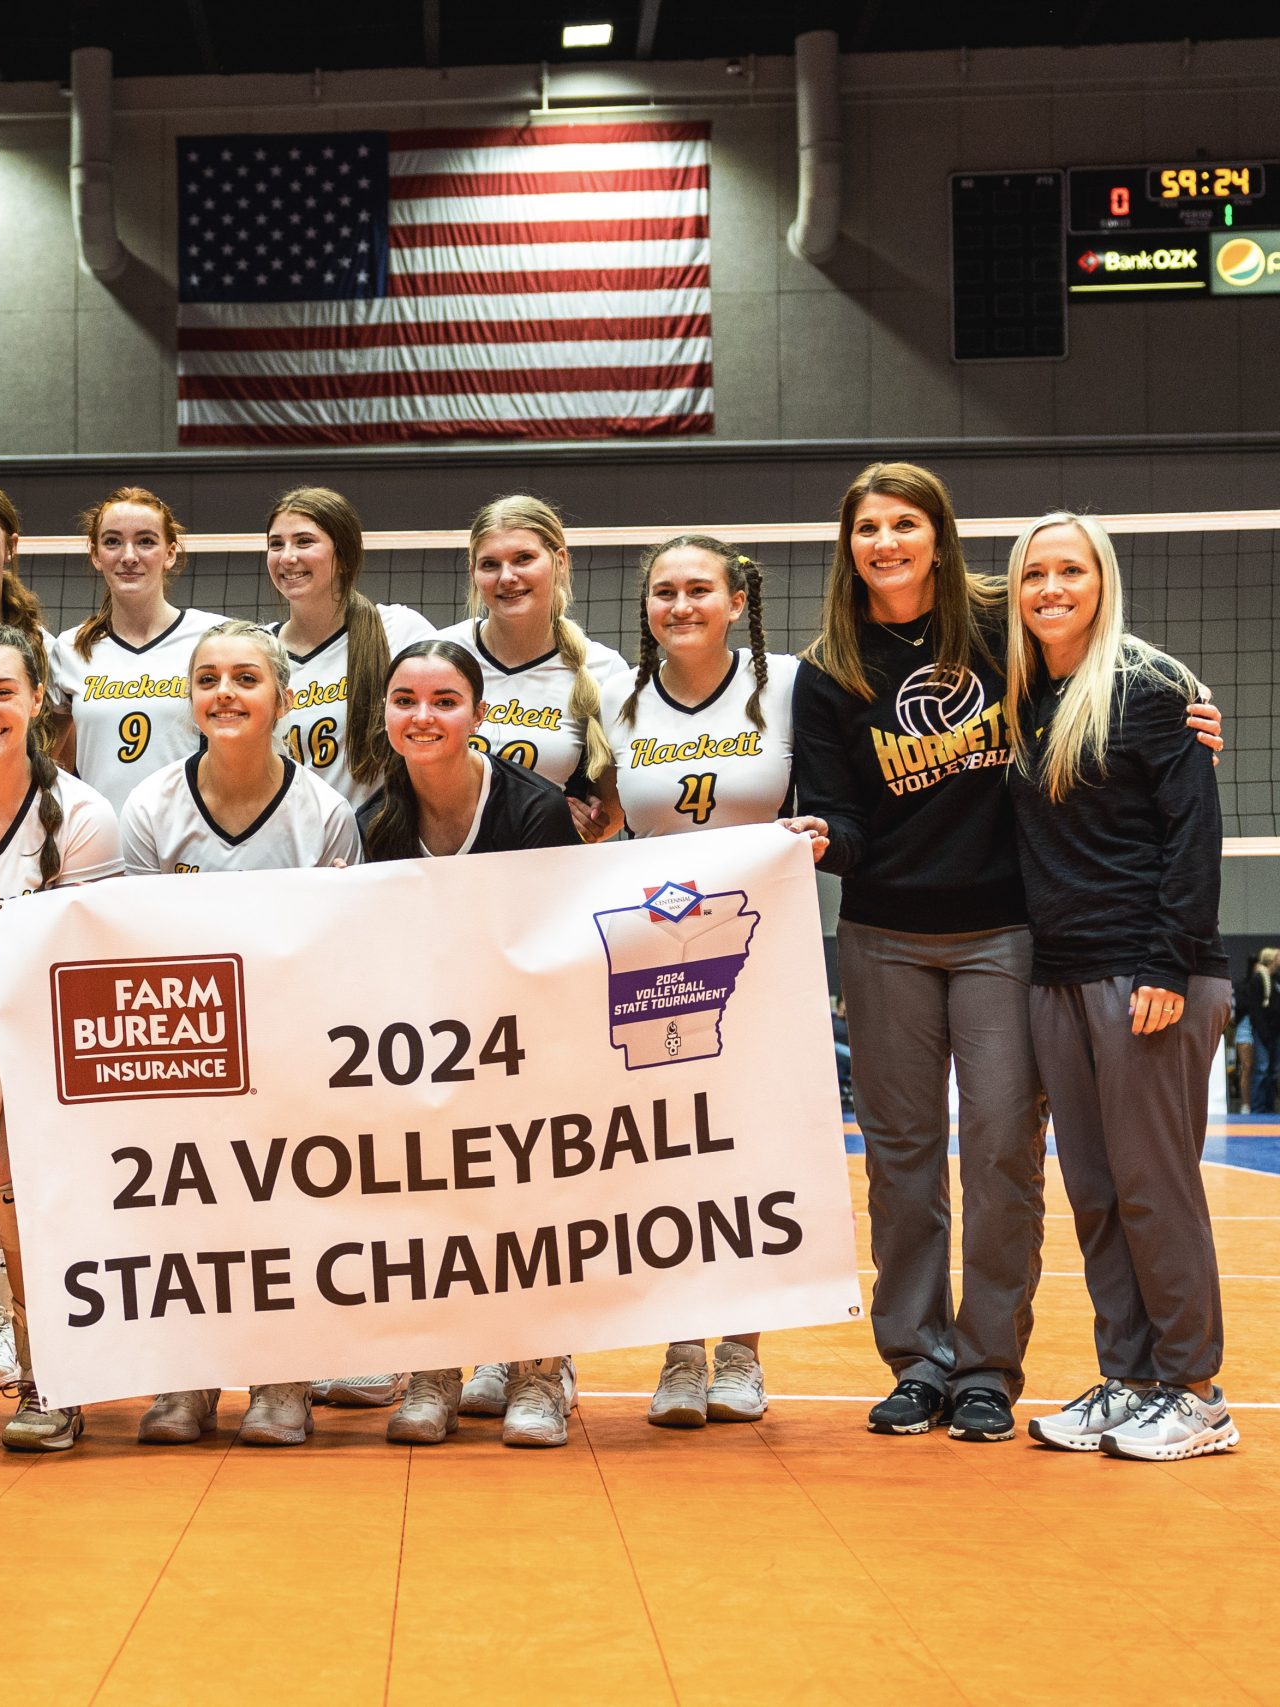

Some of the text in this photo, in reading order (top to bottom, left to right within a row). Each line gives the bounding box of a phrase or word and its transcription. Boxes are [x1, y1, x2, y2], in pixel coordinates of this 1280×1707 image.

[1160, 167, 1250, 199] 59:24
[1110, 187, 1130, 216] 0
[1224, 204, 1233, 226] 1
[83, 674, 191, 702] Hackett
[292, 676, 347, 709] cket
[486, 698, 562, 731] ckett
[117, 711, 152, 763] 9
[282, 716, 338, 768] 16
[631, 731, 763, 769] Hackett
[674, 772, 718, 824] 4
[654, 896, 692, 906] CENTENNIAL
[114, 974, 223, 1011] FARM
[636, 980, 705, 1000] VOLLEYBALL
[656, 971, 685, 986] 2024
[614, 987, 727, 1015] STATE TOURNAMENT
[73, 1011, 226, 1050] BUREAU
[326, 1014, 526, 1088] 2024
[95, 1058, 227, 1083] INSURANCE
[110, 1091, 735, 1210] 2A VOLLEYBALL
[63, 1190, 803, 1328] STATE CHAMPIONS
